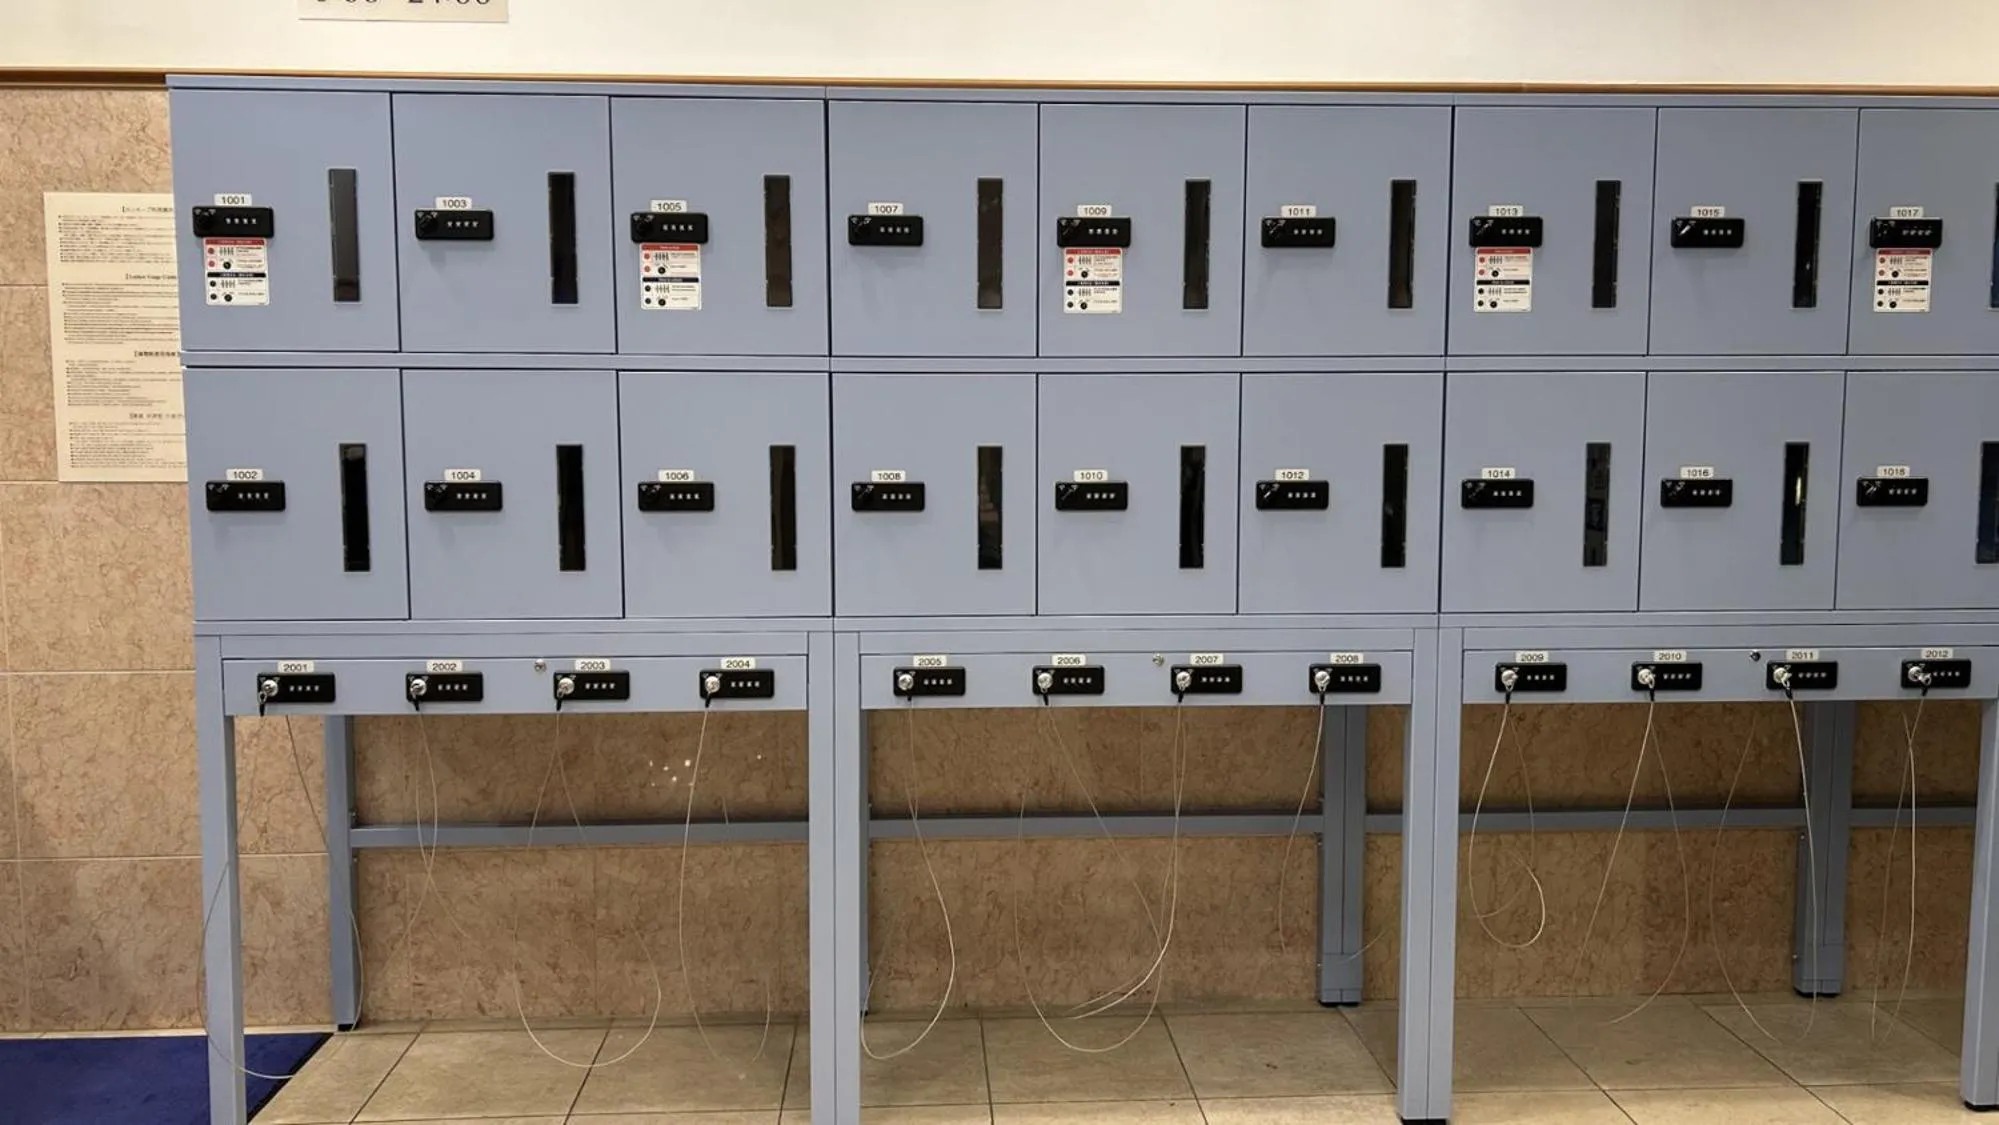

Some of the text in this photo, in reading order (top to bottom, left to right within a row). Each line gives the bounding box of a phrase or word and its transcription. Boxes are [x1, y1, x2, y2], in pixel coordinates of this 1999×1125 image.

[221, 196, 245, 205] 1001
[442, 199, 467, 208] 1003
[657, 202, 682, 211] 1005
[875, 205, 898, 214] 1007
[1084, 207, 1107, 216] 1009
[1288, 208, 1310, 216] 1011
[1496, 207, 1518, 216] 1013
[1697, 208, 1719, 217] 1015
[1897, 209, 1919, 217] 1017
[233, 470, 258, 479] 1002
[452, 471, 476, 480] 1004
[665, 472, 690, 481] 1006
[878, 472, 901, 480] 1008
[1080, 472, 1103, 480] 1010
[1281, 471, 1304, 479] 1012
[1488, 470, 1510, 478] 1014
[1687, 469, 1709, 477] 1016
[1195, 655, 1218, 664] 2007
[1658, 652, 1682, 661] 2010
[1792, 651, 1813, 660] 2011
[726, 660, 750, 668] 2004
[1057, 656, 1081, 665] 2006
[283, 663, 308, 672] 2001
[432, 663, 457, 671] 2002
[580, 661, 606, 670] 2003
